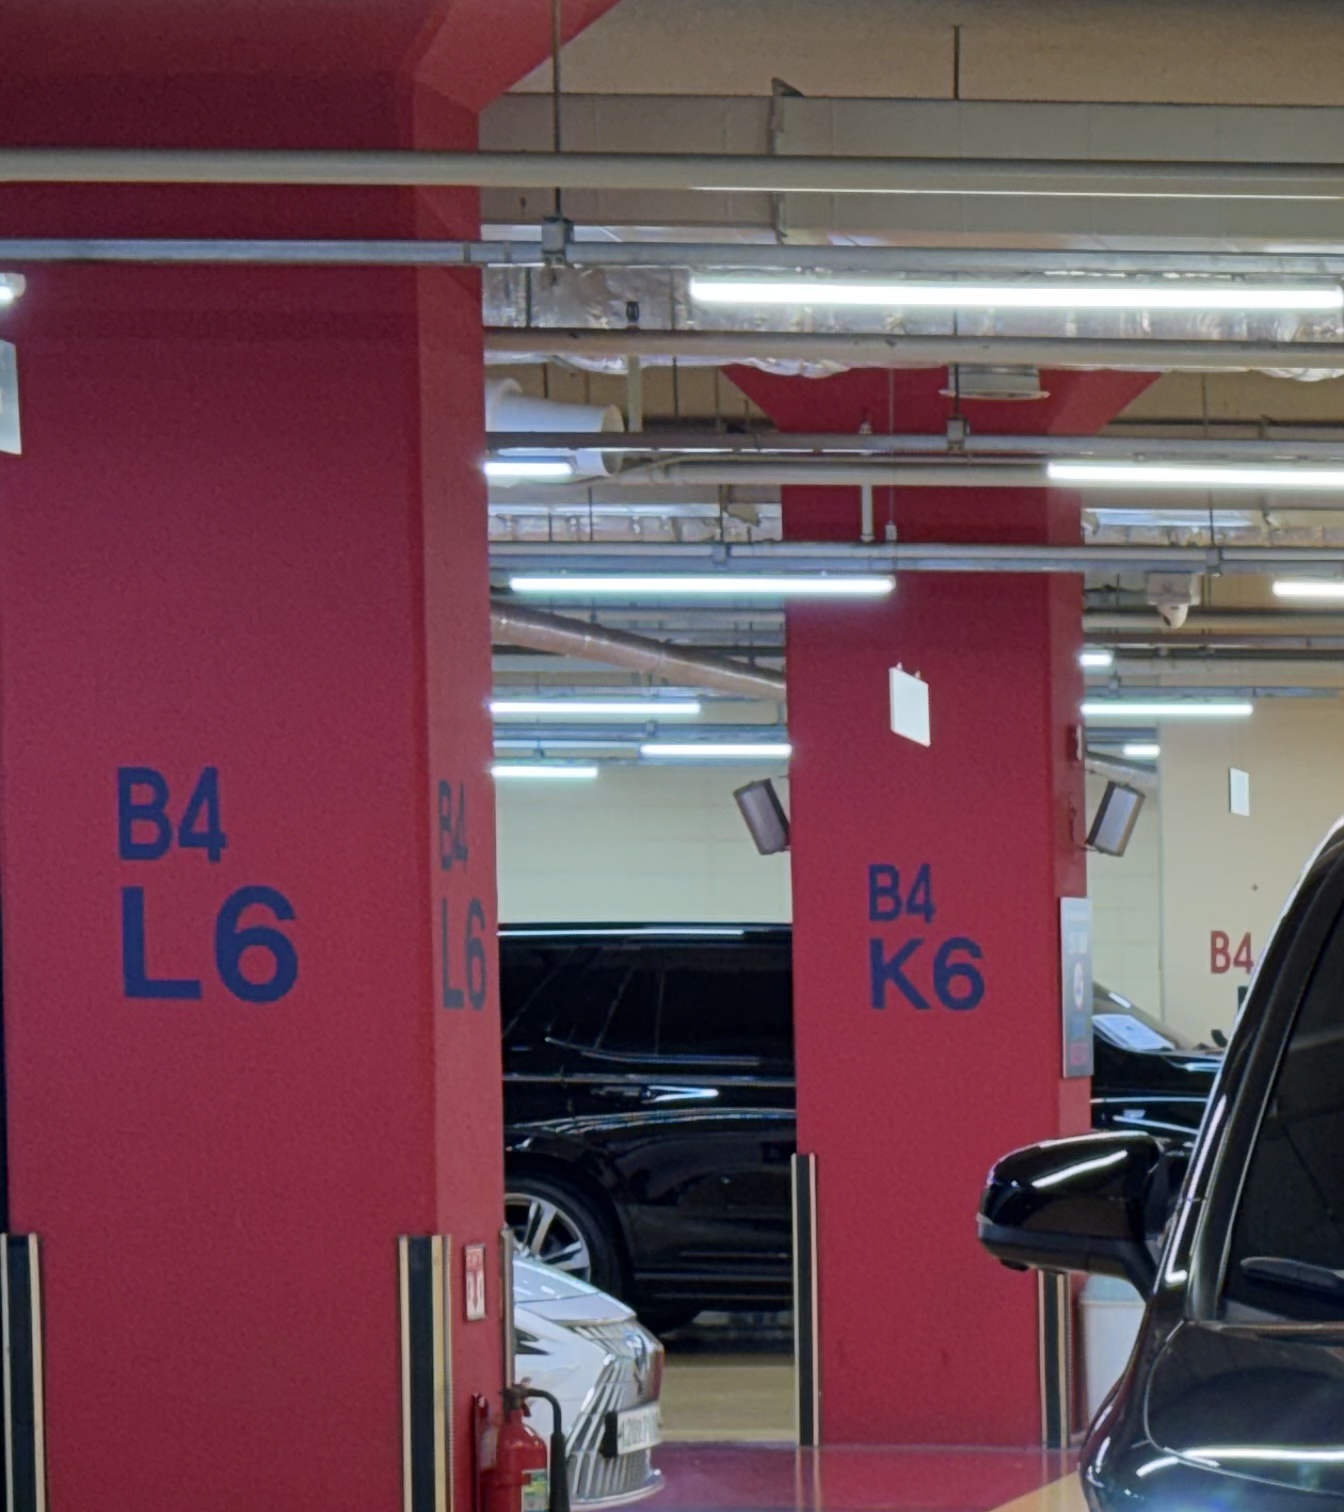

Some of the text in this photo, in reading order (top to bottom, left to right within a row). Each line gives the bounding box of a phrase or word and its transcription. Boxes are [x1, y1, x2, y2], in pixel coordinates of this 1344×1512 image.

[118, 766, 227, 863] B4
[438, 780, 469, 871] B4
[867, 863, 936, 923] B4
[121, 885, 300, 1003] L6
[440, 898, 487, 1011] L6
[868, 936, 986, 1011] K6
[1209, 930, 1254, 975] B4
